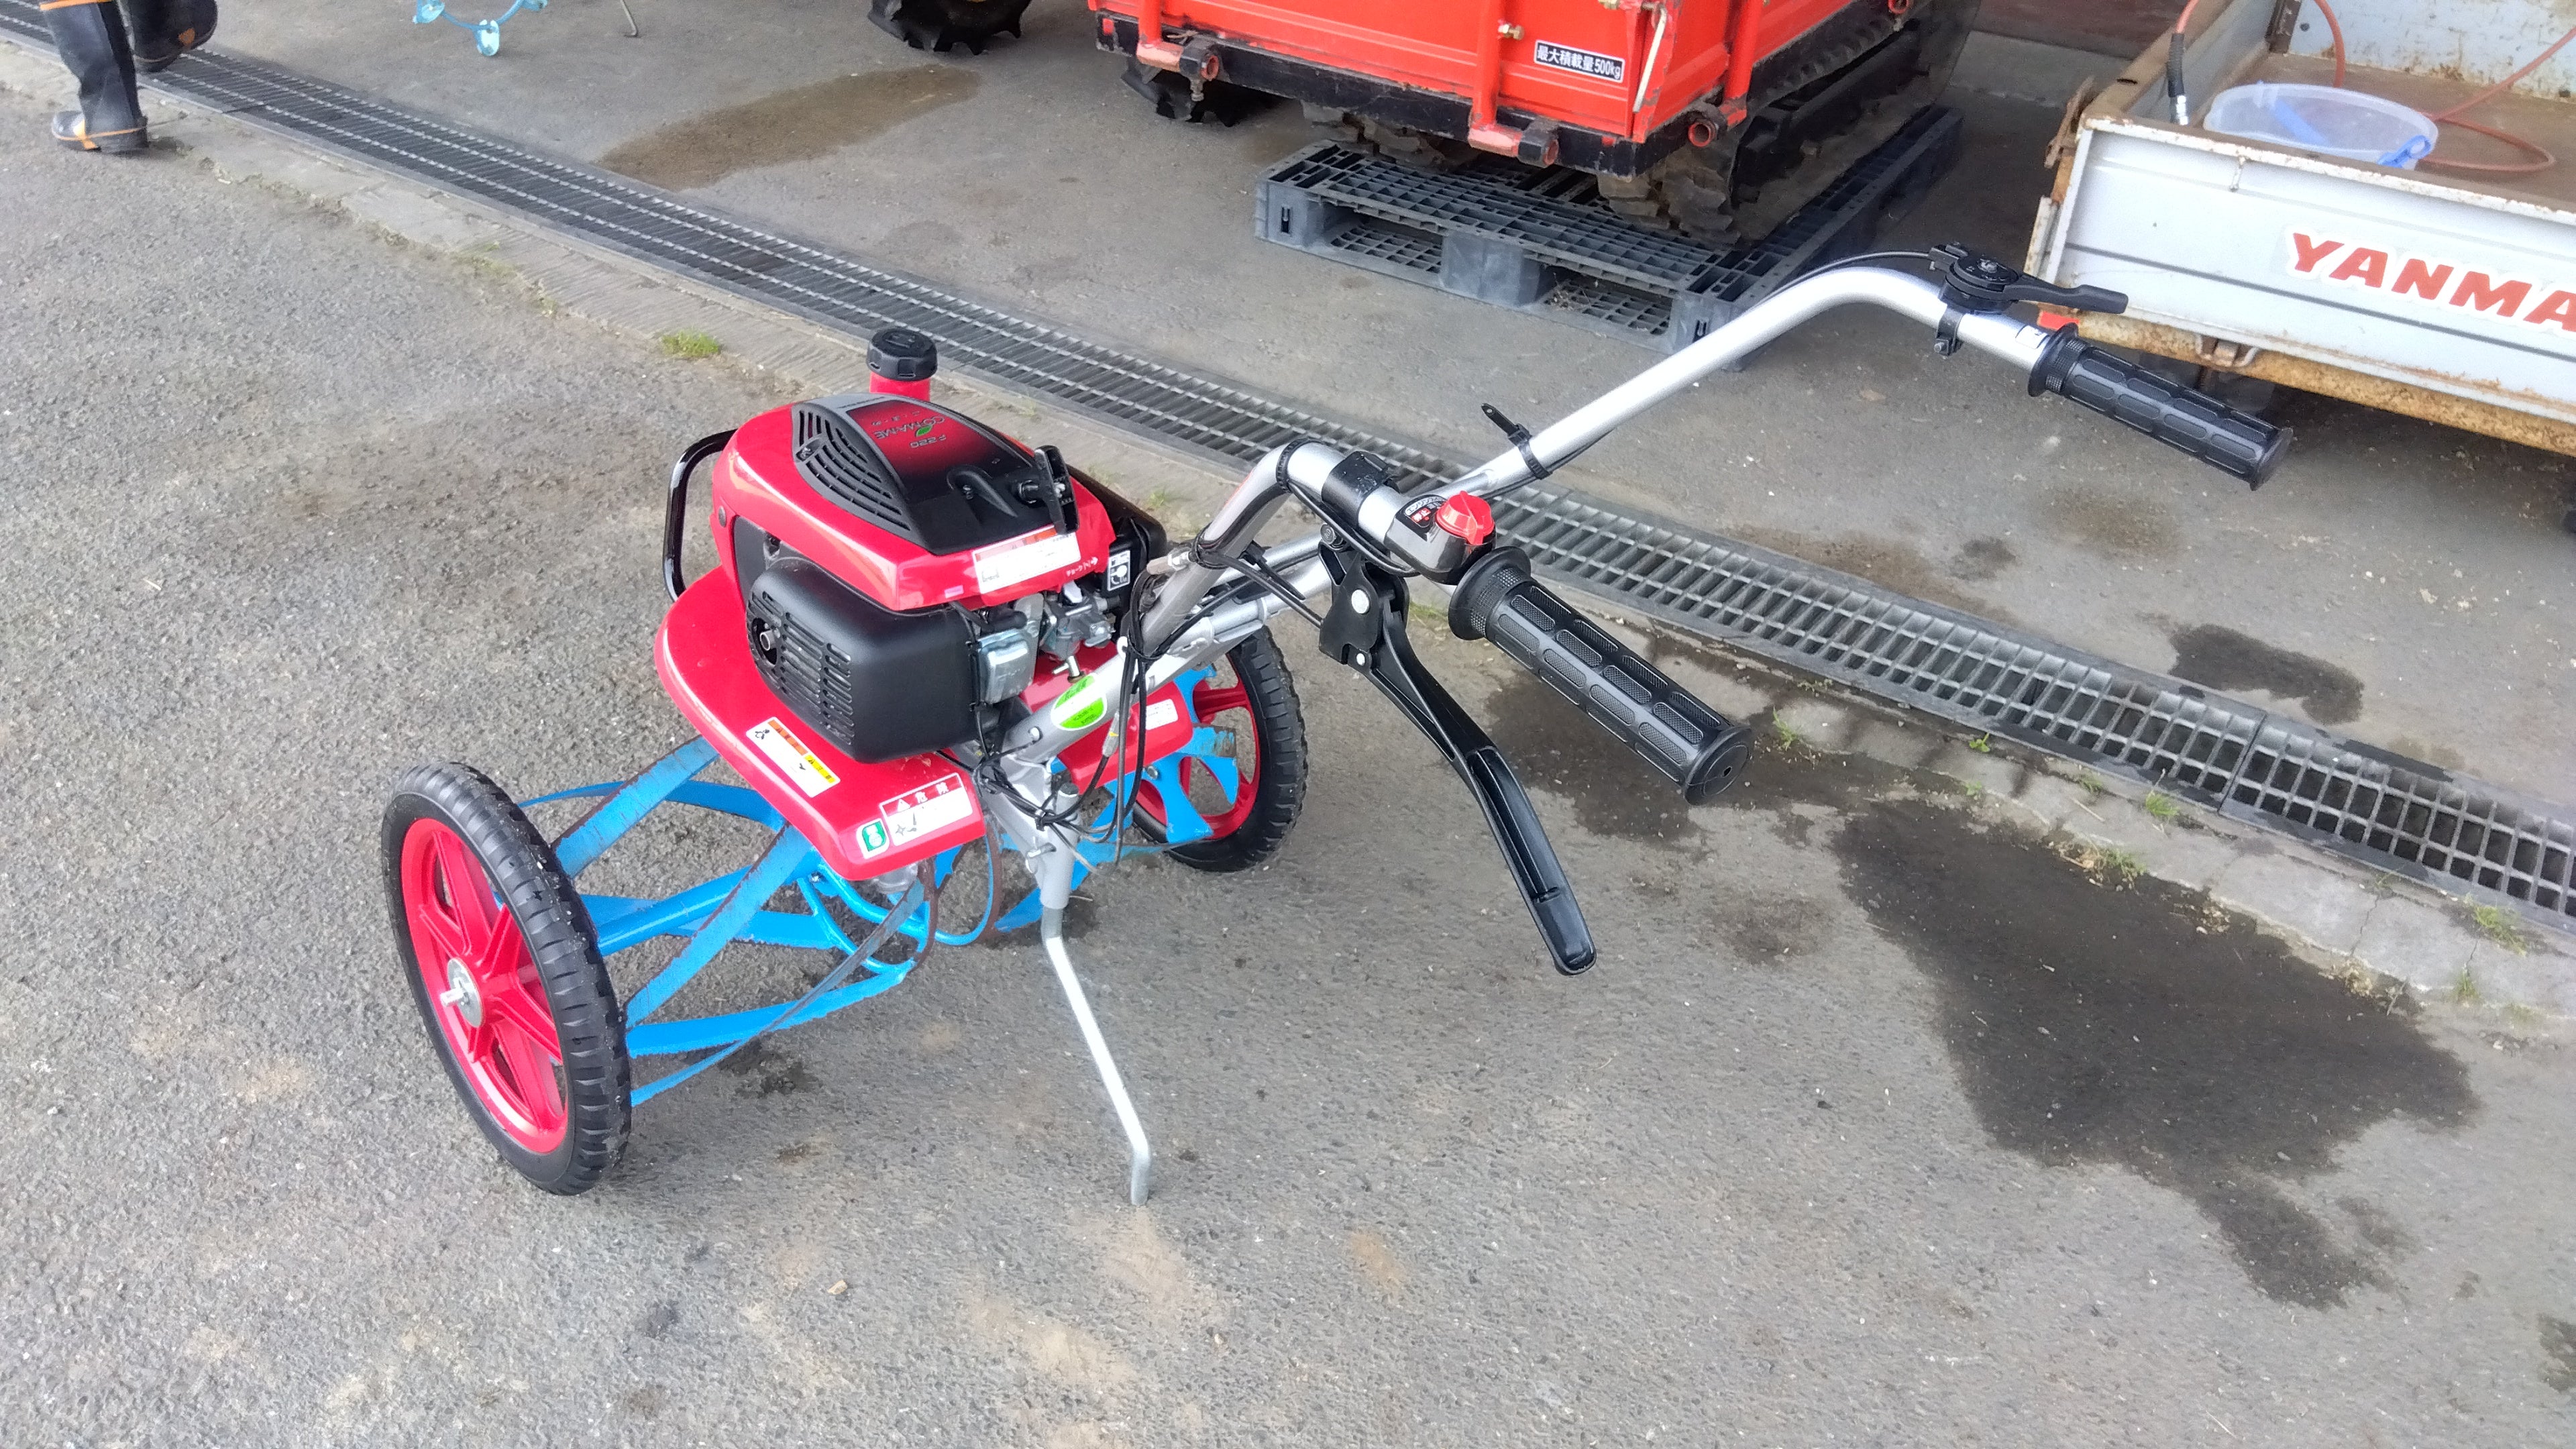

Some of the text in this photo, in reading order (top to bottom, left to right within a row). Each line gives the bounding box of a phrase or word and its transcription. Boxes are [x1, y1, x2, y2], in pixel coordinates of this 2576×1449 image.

[1537, 44, 1621, 80] 最大積載量500kg
